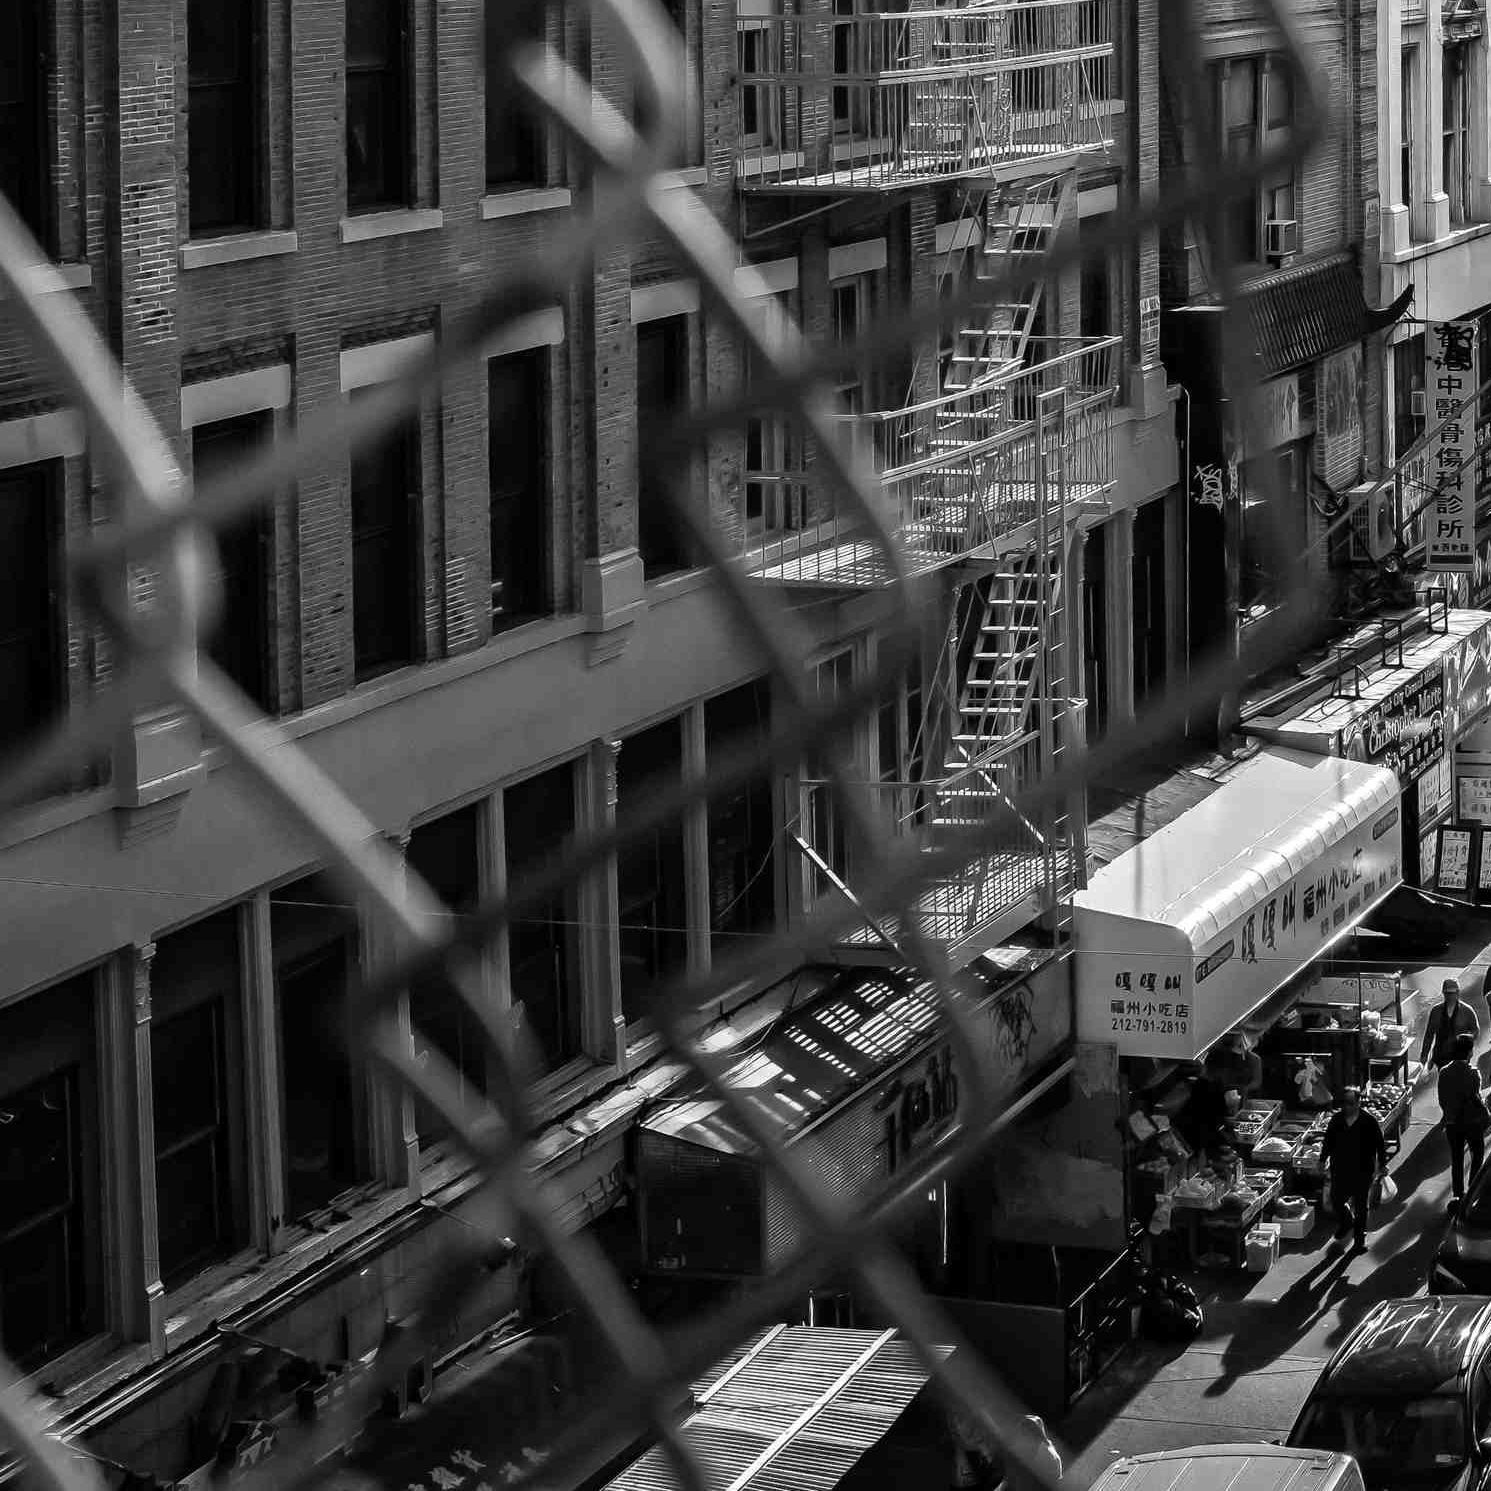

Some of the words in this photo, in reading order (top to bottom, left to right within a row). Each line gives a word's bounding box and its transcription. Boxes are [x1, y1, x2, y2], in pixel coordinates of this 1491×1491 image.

[1111, 999, 1189, 1018] 福州小吃店
[1112, 1018, 1187, 1035] 212-791-2819
